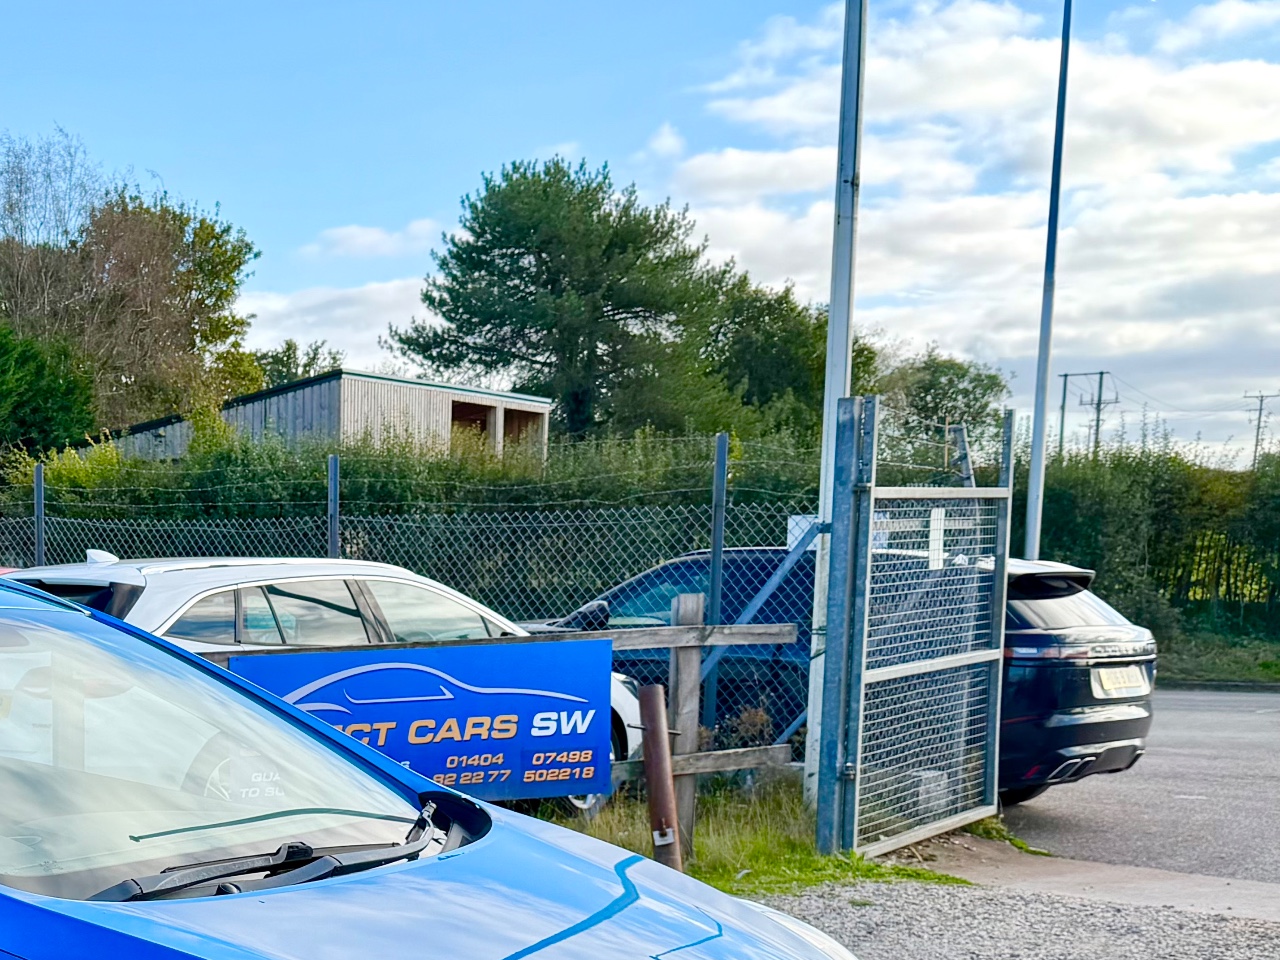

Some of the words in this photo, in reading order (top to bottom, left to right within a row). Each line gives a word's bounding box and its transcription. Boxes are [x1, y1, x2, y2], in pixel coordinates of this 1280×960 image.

[407, 714, 519, 745] CARS
[530, 709, 596, 737] SW
[446, 753, 504, 769] 01404
[532, 750, 593, 766] 07498
[523, 767, 595, 783] 502218
